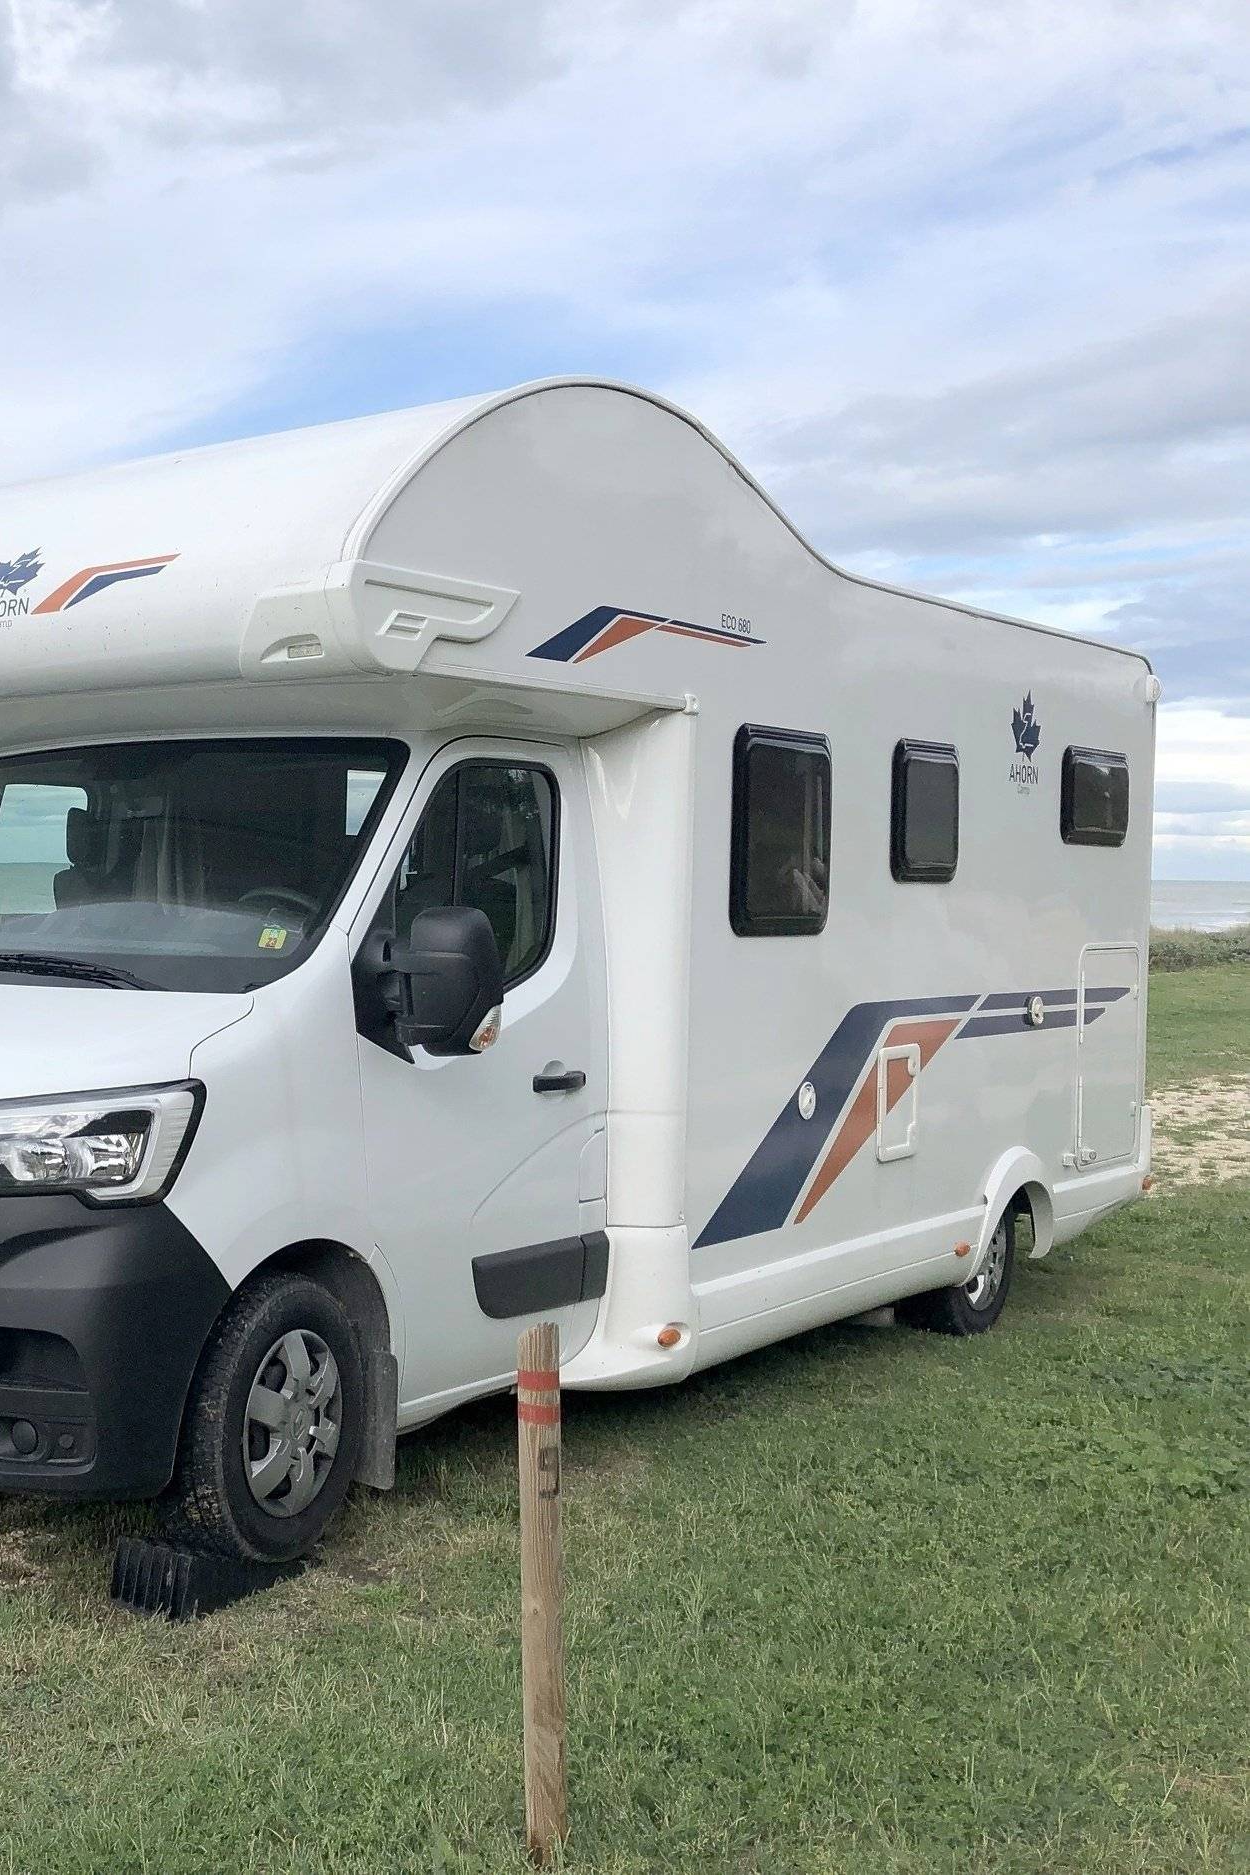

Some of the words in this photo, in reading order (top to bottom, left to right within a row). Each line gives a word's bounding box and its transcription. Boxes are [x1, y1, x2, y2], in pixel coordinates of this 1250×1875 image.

[721, 613, 736, 630] ECO
[738, 618, 751, 634] 680
[1009, 763, 1038, 785] AHORN
